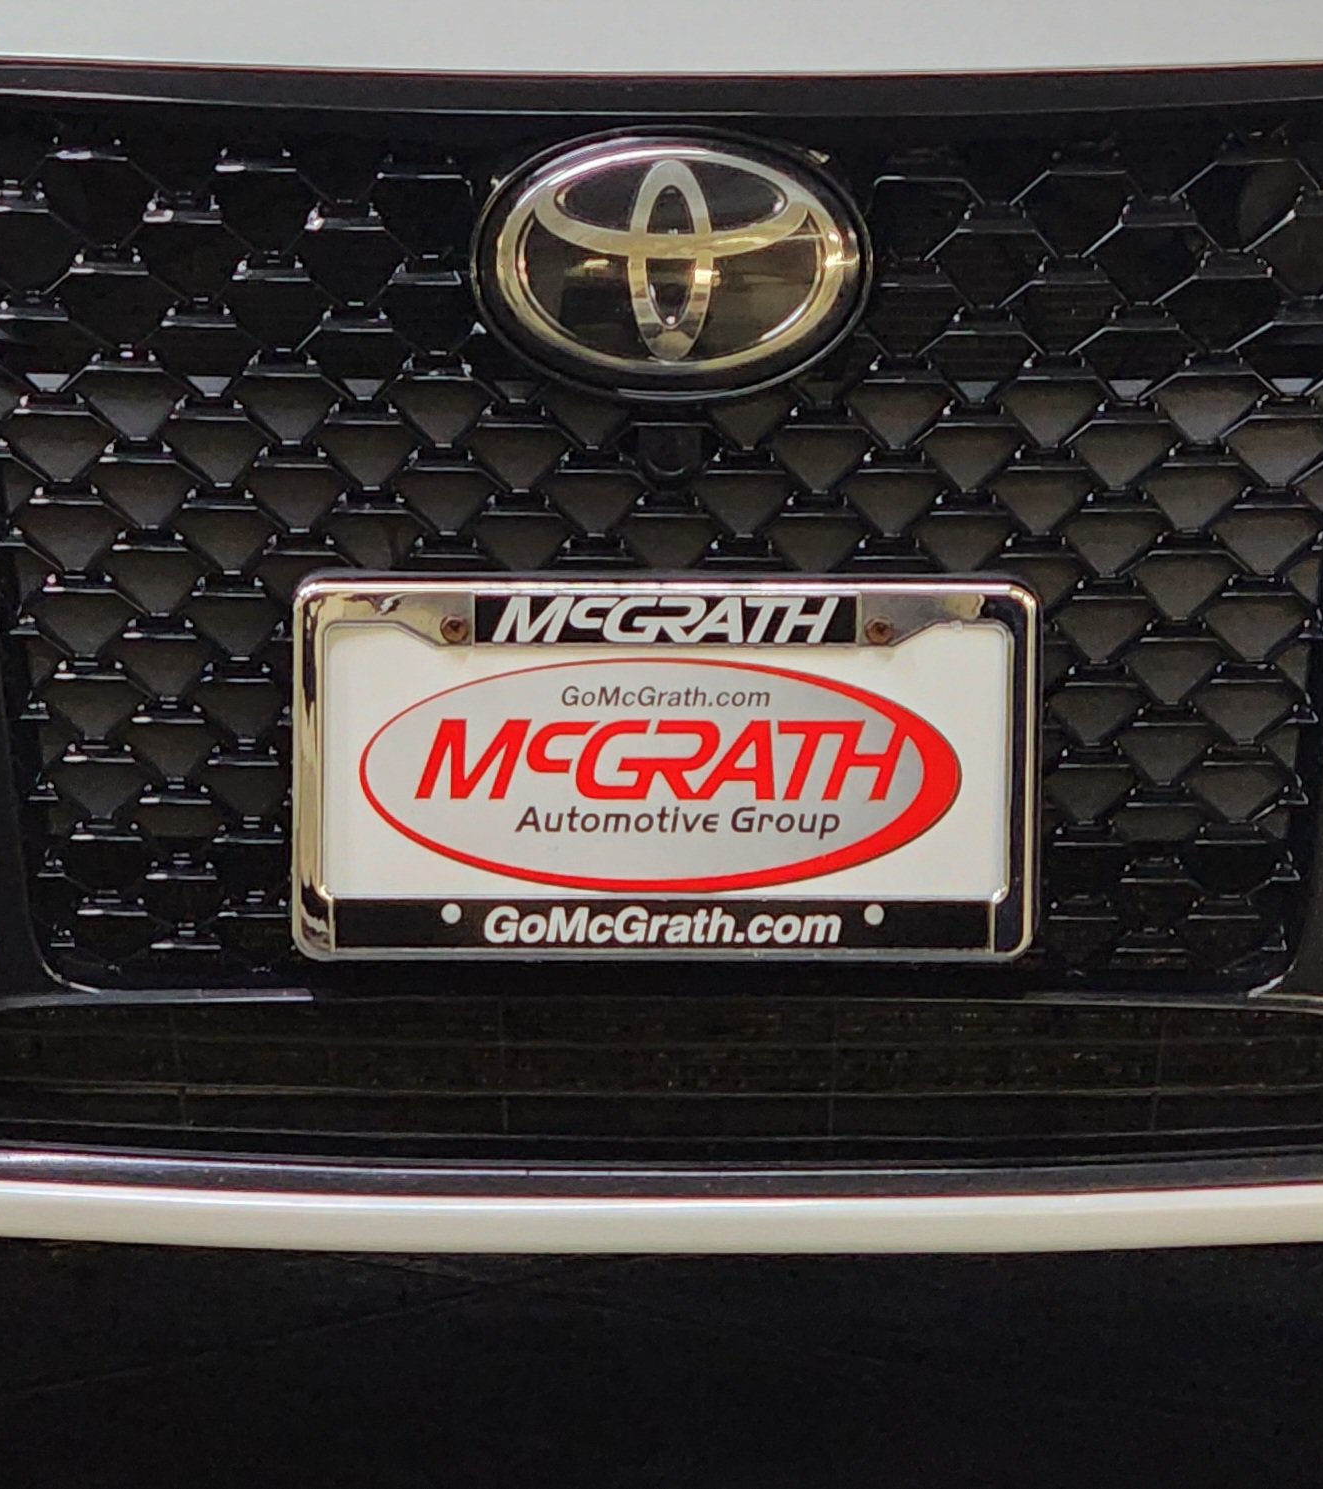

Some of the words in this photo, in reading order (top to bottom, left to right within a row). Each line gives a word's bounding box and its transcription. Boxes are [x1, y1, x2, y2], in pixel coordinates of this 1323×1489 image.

[561, 685, 771, 709] GoMcGrath.com
[515, 806, 719, 833] Automotive
[730, 805, 841, 840] Group
[483, 905, 842, 944] GoMcGrath.com
